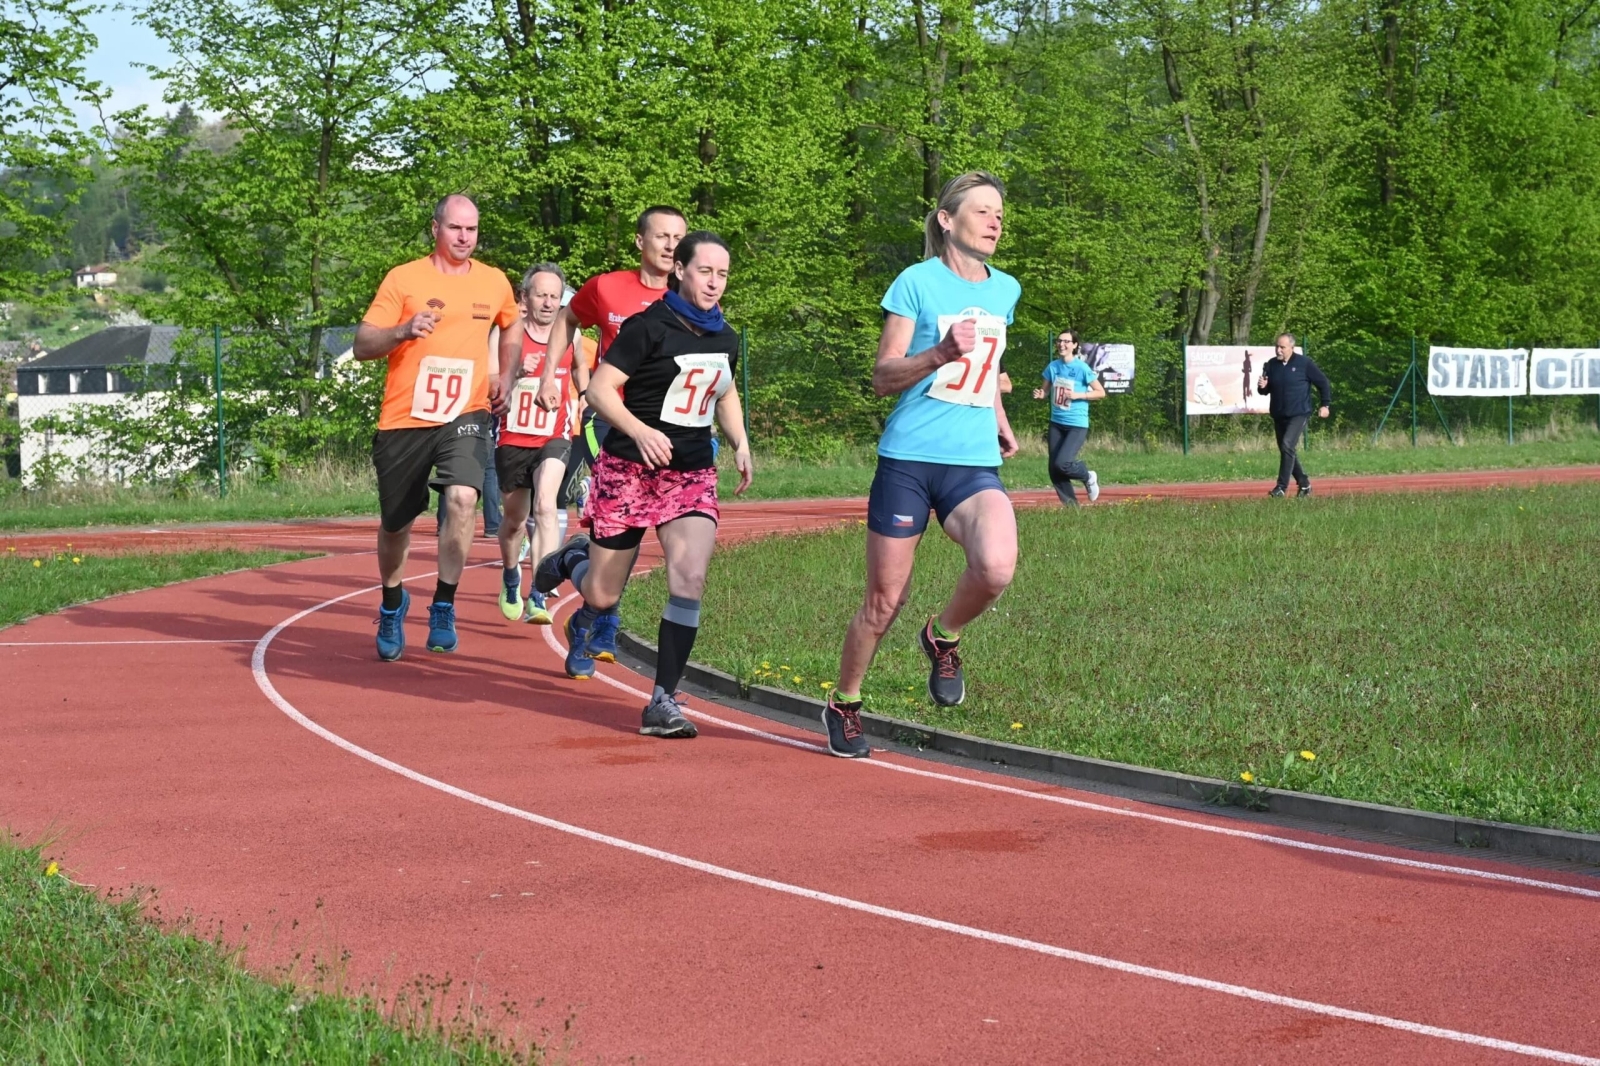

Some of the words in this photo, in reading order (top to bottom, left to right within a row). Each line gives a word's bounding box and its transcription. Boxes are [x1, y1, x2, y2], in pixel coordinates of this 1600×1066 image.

[426, 365, 446, 373] PIVOVAR
[945, 336, 998, 394] 57
[1431, 352, 1525, 389] START
[423, 373, 463, 415] 59
[674, 368, 722, 416] 56
